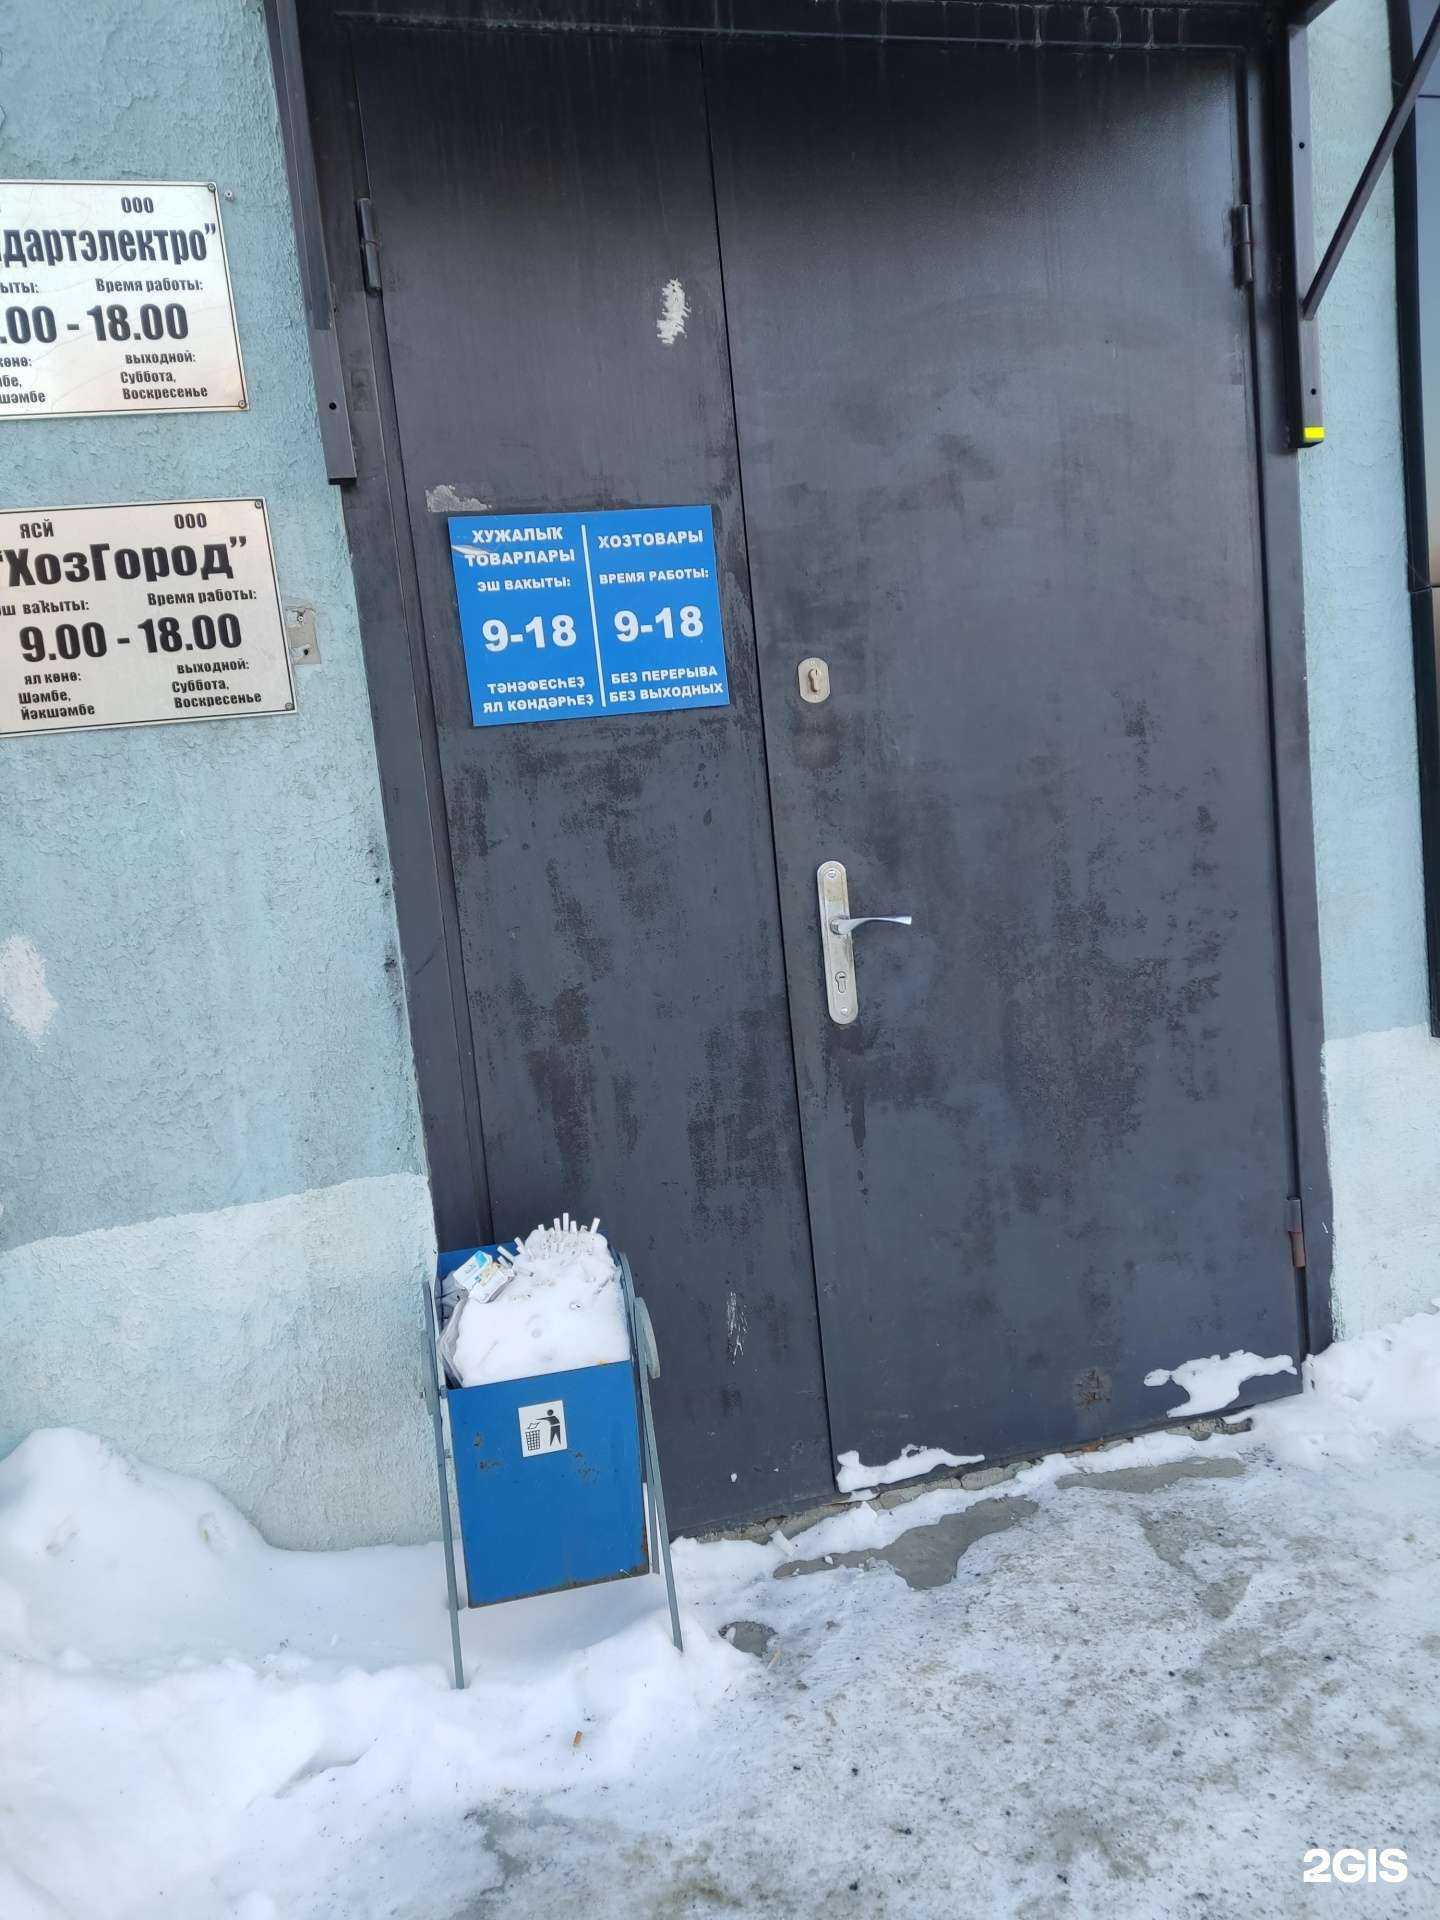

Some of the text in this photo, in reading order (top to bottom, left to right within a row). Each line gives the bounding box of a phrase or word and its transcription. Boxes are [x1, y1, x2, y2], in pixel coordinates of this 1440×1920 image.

[121, 197, 154, 213] ООО
[96, 278, 203, 293] Время работы:
[87, 303, 188, 341] 18.00
[125, 350, 196, 364] выходной:
[121, 371, 176, 385] Суббота,
[123, 387, 208, 400] Воскресенье
[20, 519, 54, 539] ЯСЙ
[174, 513, 207, 529] ООО
[598, 530, 704, 549] ХОЗТОВАРЫ
[465, 549, 575, 567] ТОВАРЛАРЫ
[599, 568, 709, 585] ВРЕМЯ РАБОТЫ:
[477, 581, 500, 592] ЭШ
[147, 589, 256, 606] Время работы:
[613, 605, 704, 643] 9-18
[19, 622, 107, 663] 9.00
[138, 613, 242, 653] 18.00
[482, 614, 577, 652] 9-18
[177, 659, 249, 674] выходной:
[611, 665, 717, 684] БЕЗ ПЕРЕРЫВА
[24, 671, 81, 685] ял көнө:
[172, 678, 229, 693] Суббота,
[18, 691, 71, 704] Шәмбе,
[174, 692, 262, 709] Воскресенье
[609, 683, 724, 703] БЕЗ ВЫХОДНЫХ
[21, 704, 95, 721] Йәкшәмбе
[483, 701, 503, 714] ЯЛ
